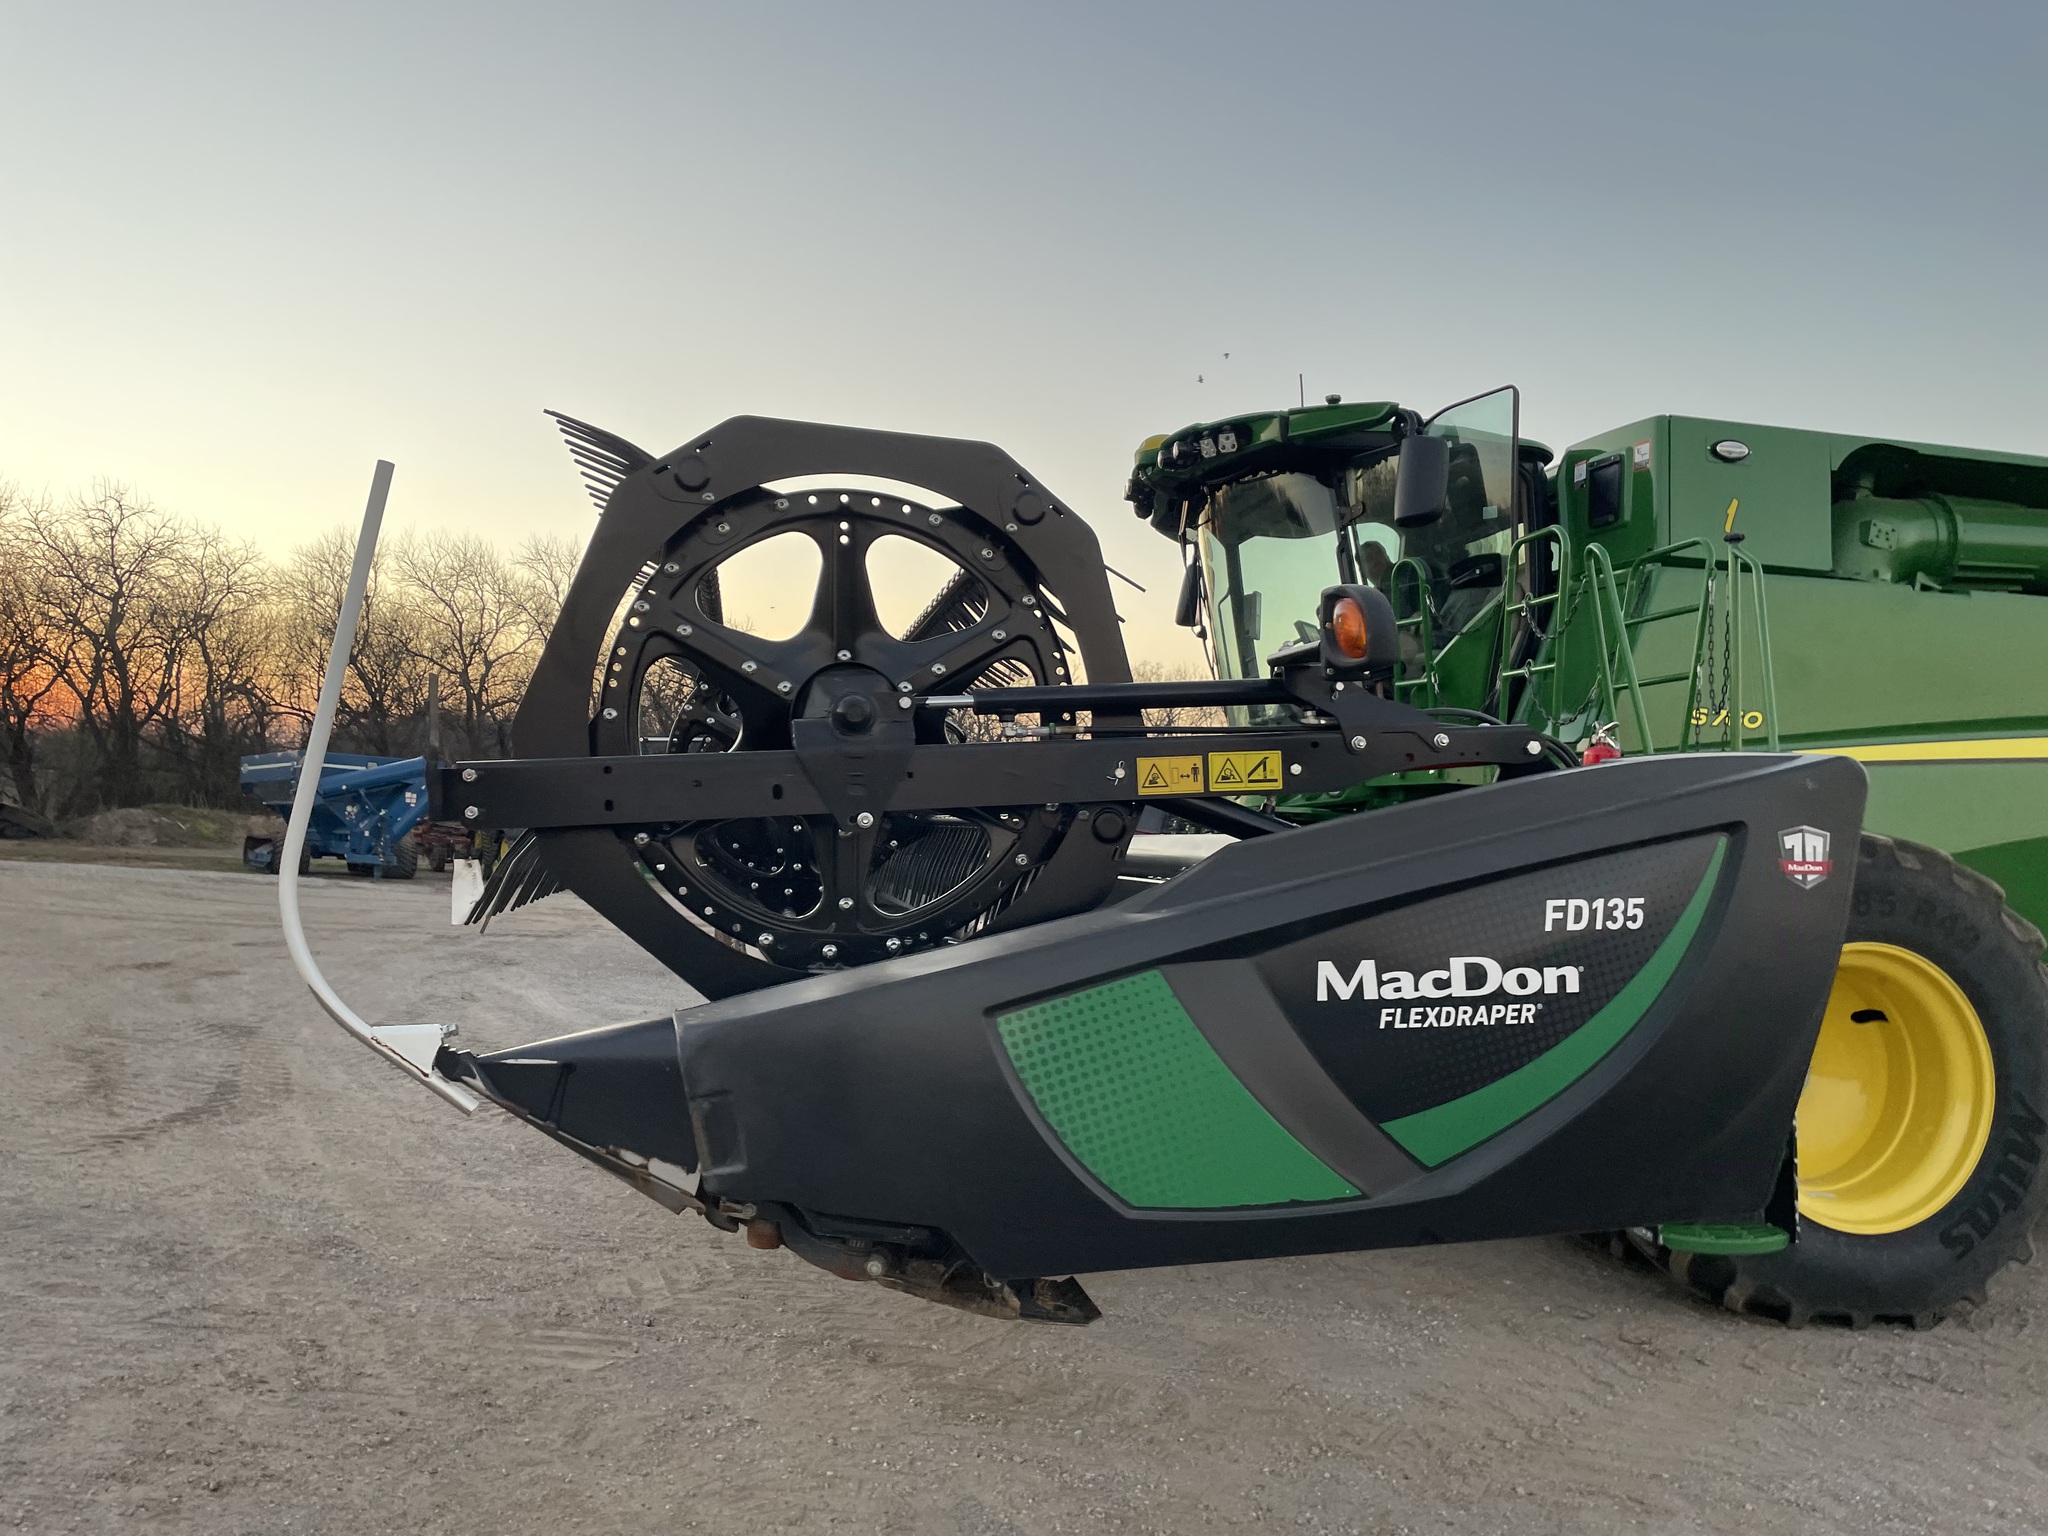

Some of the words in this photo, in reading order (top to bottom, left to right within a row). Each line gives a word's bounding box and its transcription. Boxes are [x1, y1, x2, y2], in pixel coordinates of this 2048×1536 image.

[1690, 707, 1763, 729] S70
[1787, 863, 1823, 872] MacDon
[1544, 897, 1645, 932] FD135
[1316, 956, 1580, 1002] MacDon
[1379, 1003, 1537, 1029] FLEXDRAPER
